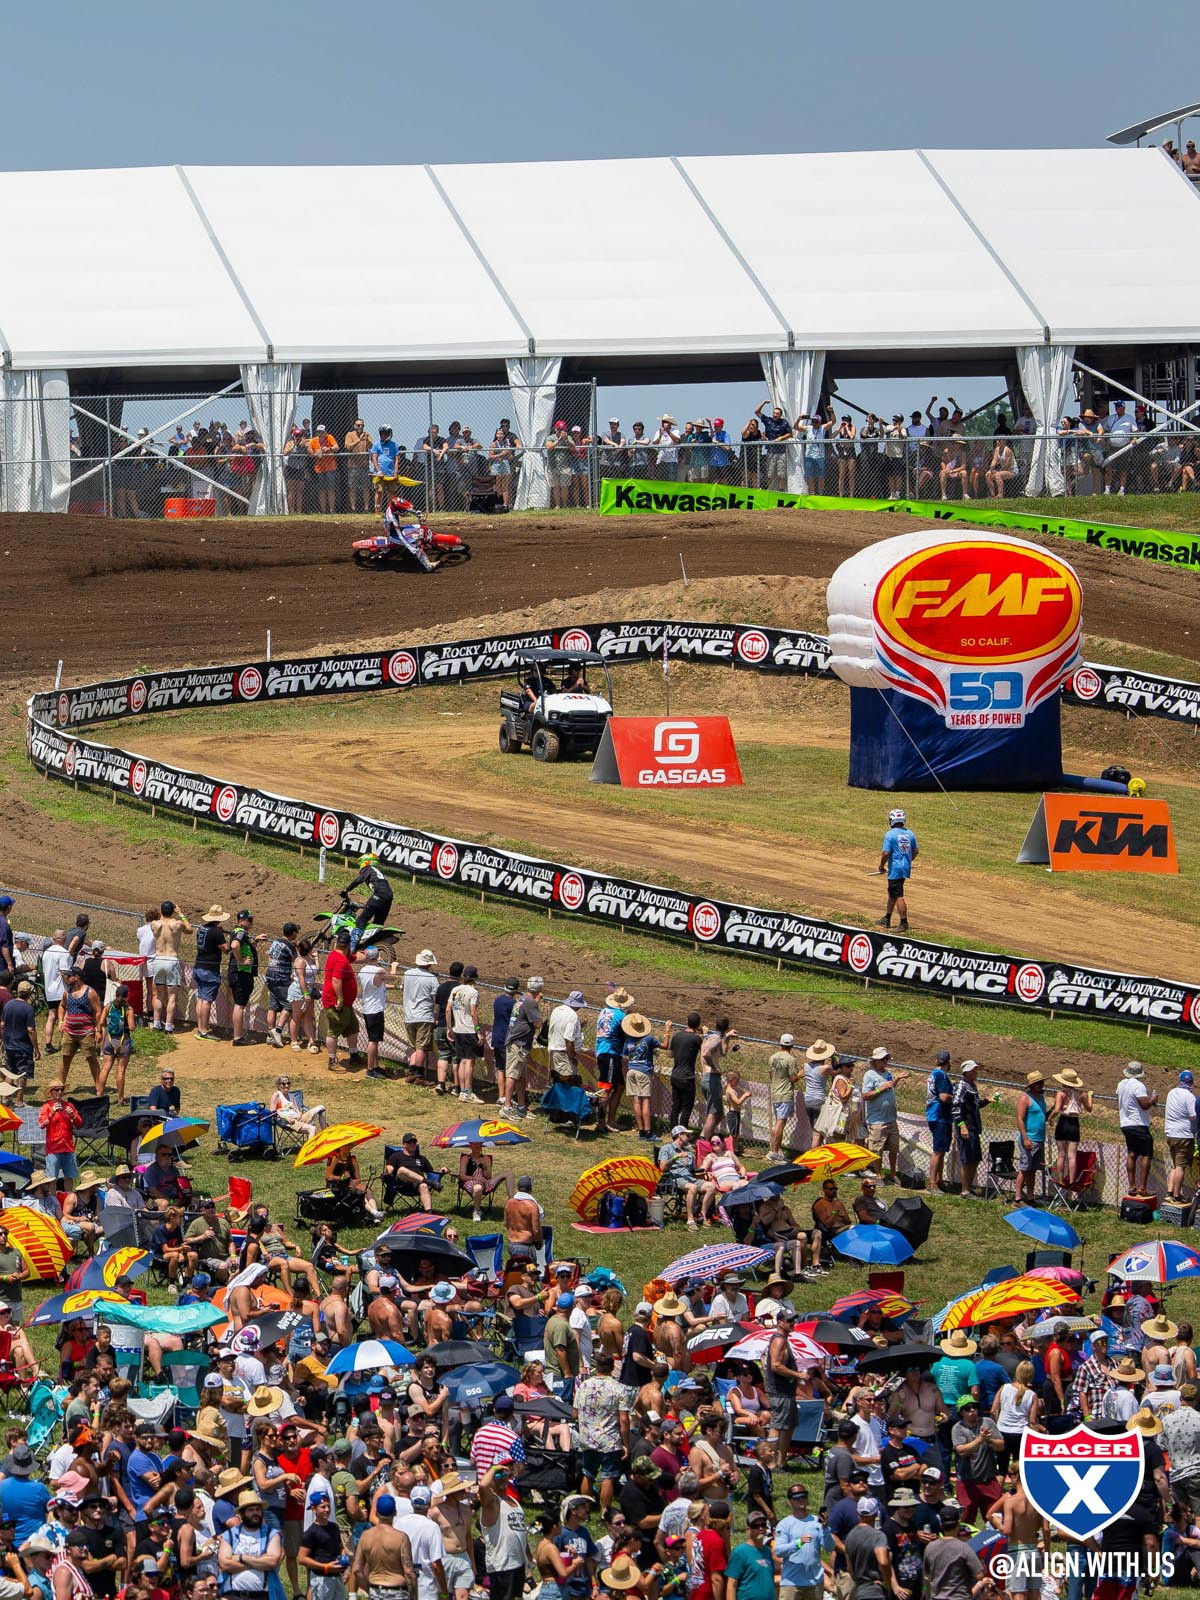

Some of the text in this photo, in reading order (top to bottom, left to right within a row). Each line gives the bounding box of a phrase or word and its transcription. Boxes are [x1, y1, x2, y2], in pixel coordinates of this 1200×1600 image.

[615, 485, 754, 512] Kawasaki
[893, 573, 1067, 619] FMF
[960, 637, 1012, 647] SO CALIF.
[950, 671, 1023, 711] 50
[951, 712, 1022, 726] YEARS OF POWER
[638, 768, 726, 785] GASGAS
[1053, 810, 1168, 858] KTM
[687, 1328, 733, 1350] MSR
